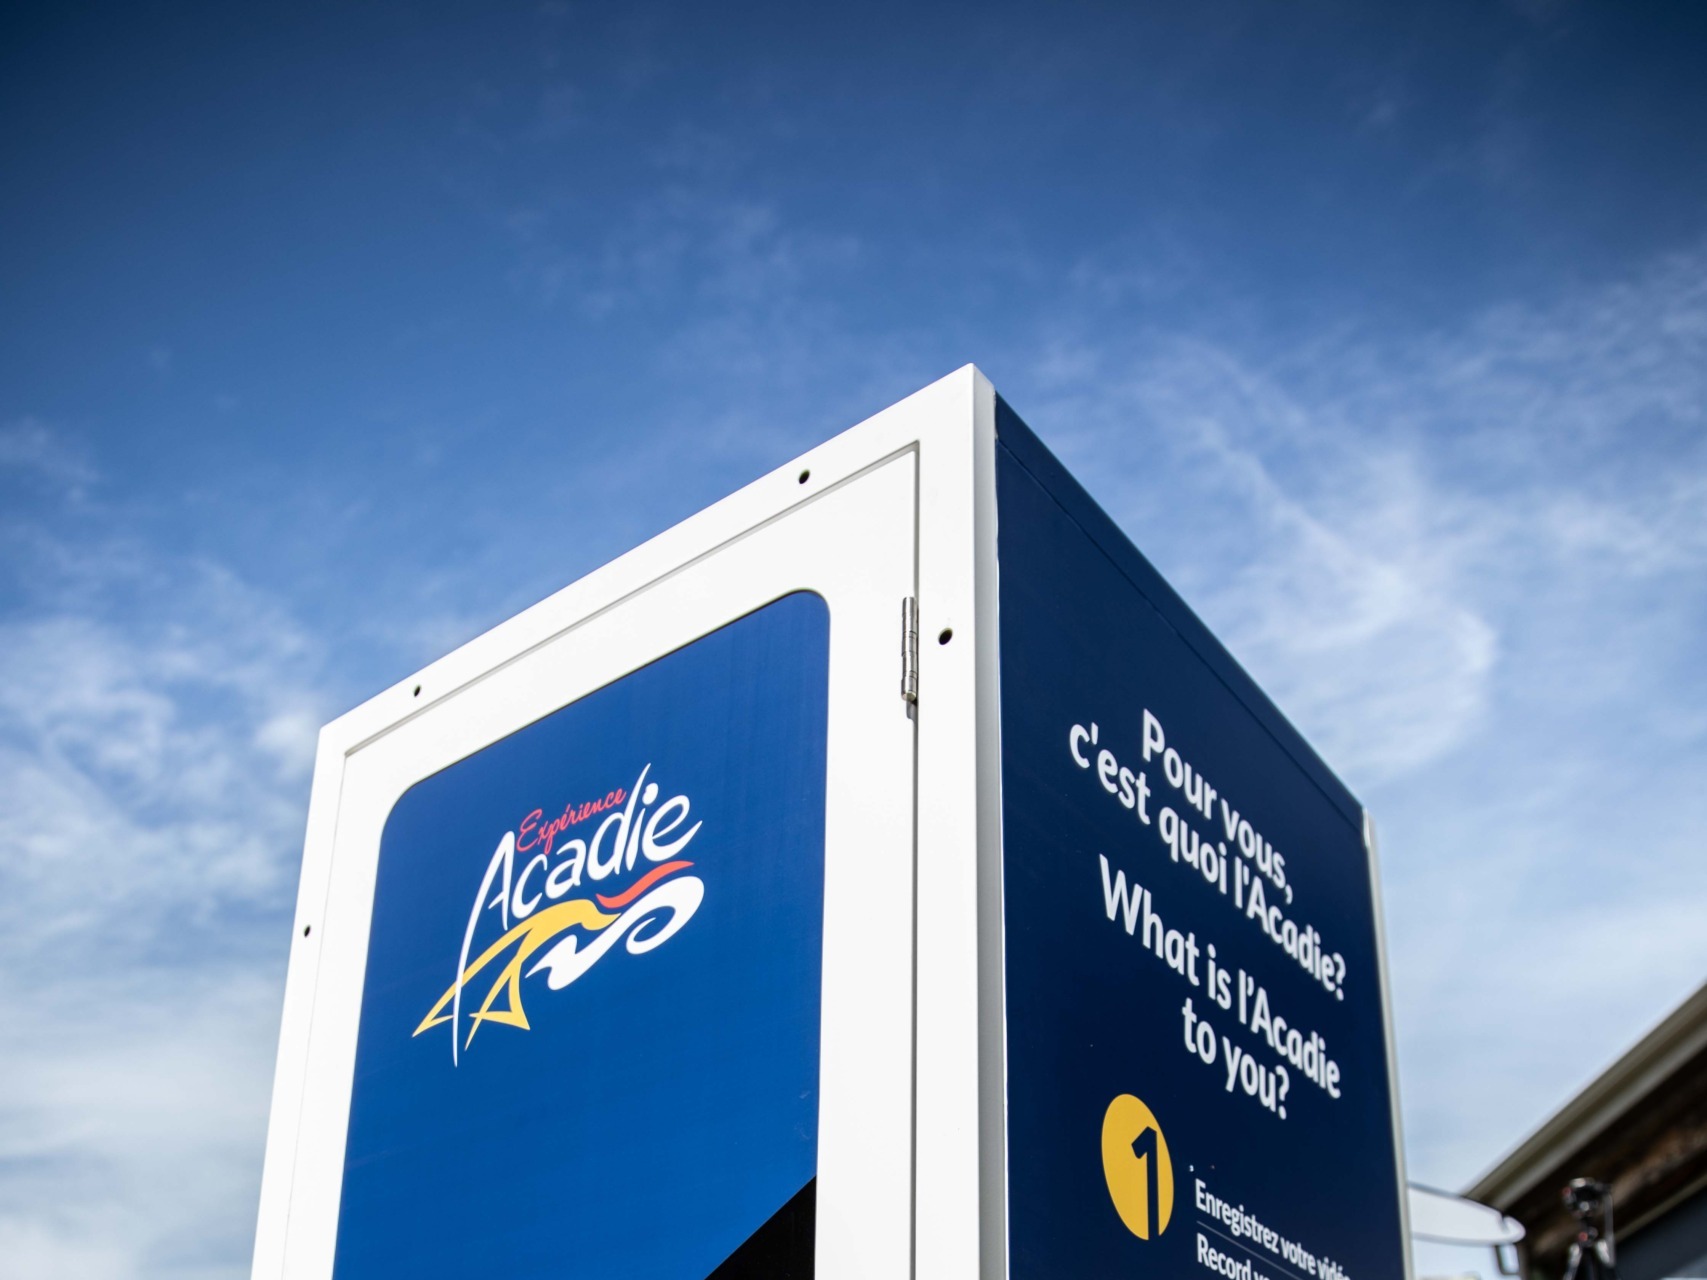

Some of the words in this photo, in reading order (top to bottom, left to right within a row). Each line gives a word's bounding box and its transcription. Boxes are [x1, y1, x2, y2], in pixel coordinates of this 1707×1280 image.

[516, 787, 627, 854] Expérience
[1070, 721, 1151, 825] c'est
[1159, 806, 1227, 895] quoi
[1235, 856, 1346, 1000] l'Acadie?
[1142, 708, 1217, 820] Pour
[1221, 798, 1293, 904] vous,
[453, 762, 703, 1068] Acadie
[1100, 853, 1200, 986] What
[1208, 944, 1232, 1010] is
[1239, 969, 1341, 1098] l'Acadie
[1182, 998, 1216, 1064] to
[1222, 1037, 1290, 1120] you?
[1131, 1126, 1159, 1240] 1
[1196, 1178, 1279, 1253] Enregistrez
[1281, 1236, 1316, 1276] votre
